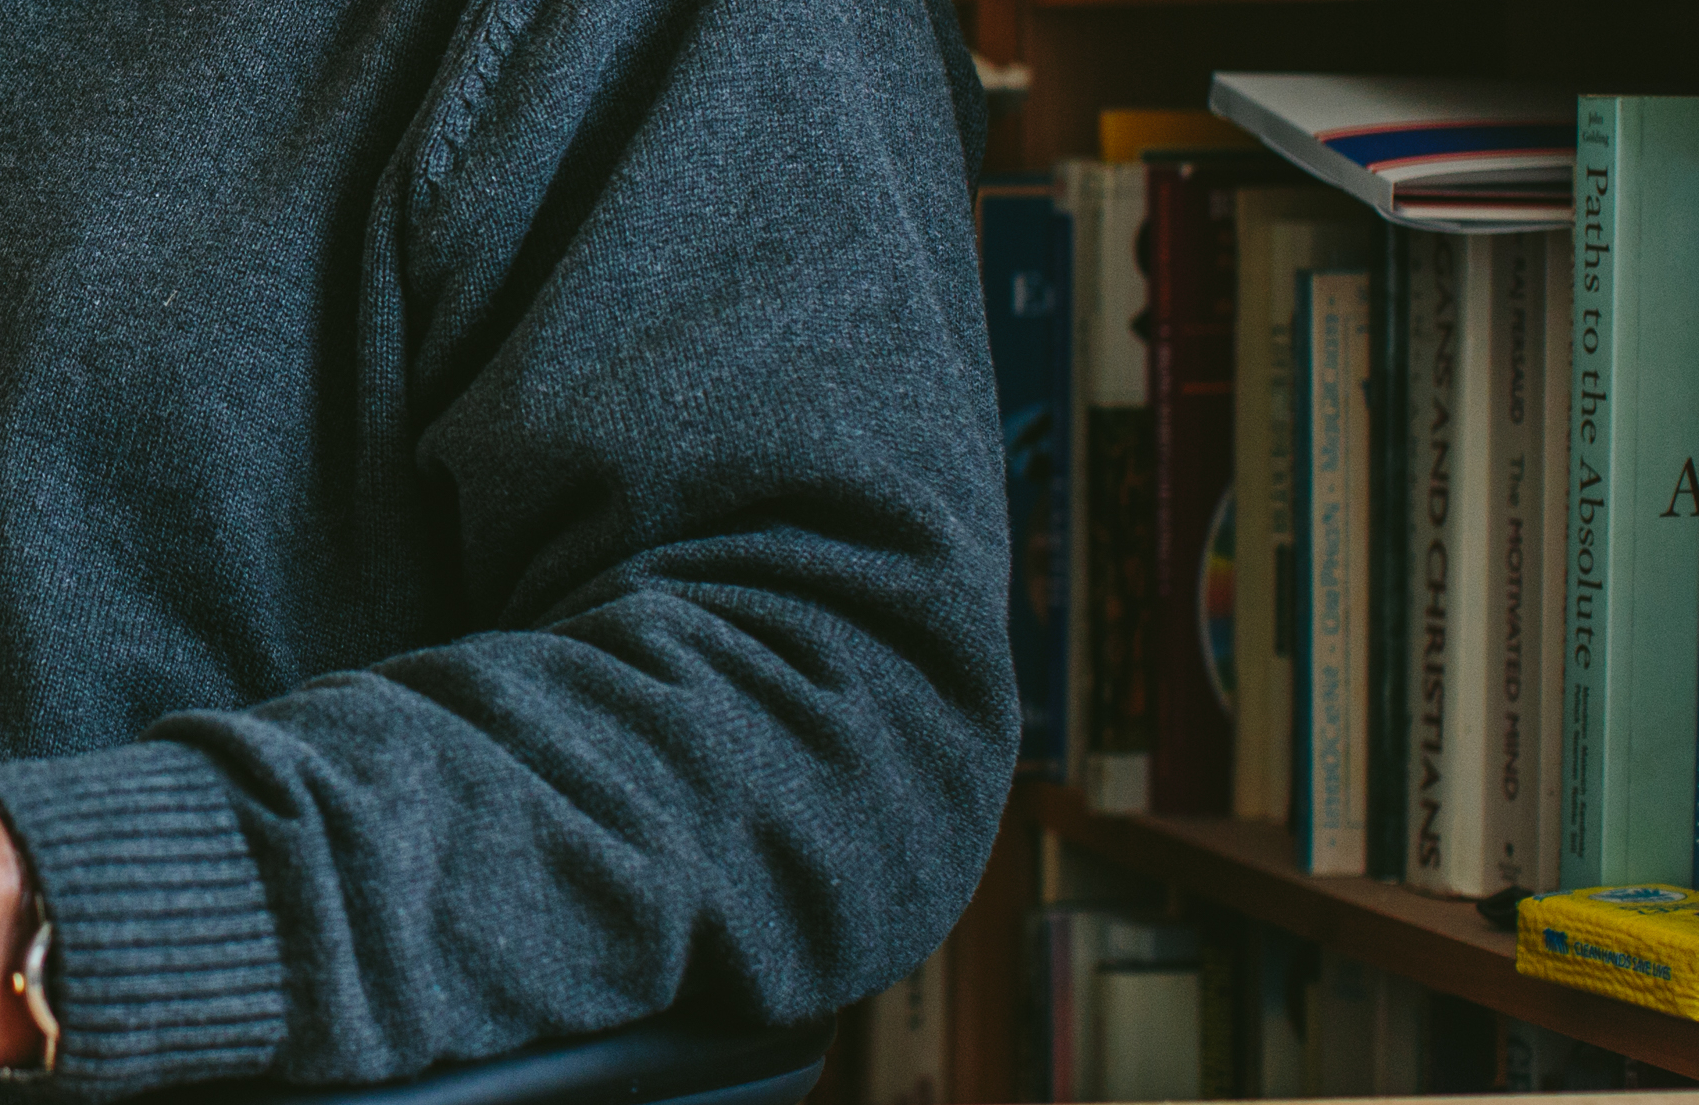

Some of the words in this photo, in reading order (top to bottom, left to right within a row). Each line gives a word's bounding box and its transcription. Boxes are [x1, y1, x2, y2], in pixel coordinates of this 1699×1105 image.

[1584, 164, 1611, 294] Paths
[1509, 305, 1527, 427] PERSAUD
[1581, 306, 1602, 356] to
[1426, 397, 1450, 527] AND
[1580, 368, 1608, 446] the
[1507, 516, 1522, 703] MOTIVATED
[1571, 462, 1605, 671] Absolute
[1418, 538, 1448, 870] CHRISTIANS
[1503, 711, 1519, 803] MIND
[1632, 956, 1652, 977] SAVE
